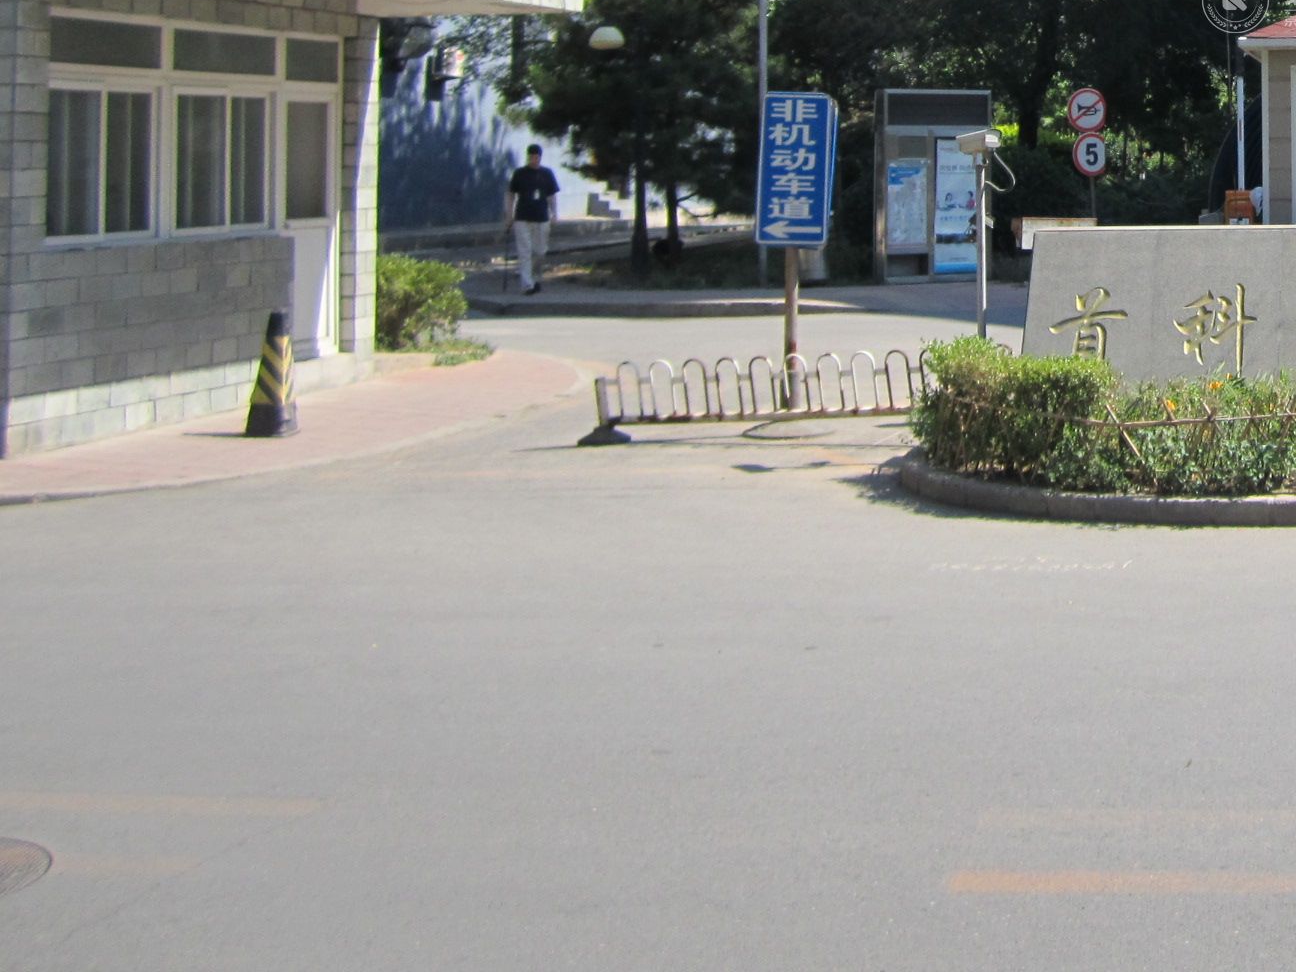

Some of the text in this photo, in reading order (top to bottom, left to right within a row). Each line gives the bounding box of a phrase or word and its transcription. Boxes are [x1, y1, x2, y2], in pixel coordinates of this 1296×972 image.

[767, 99, 819, 219] 非机动车道
[1085, 143, 1098, 166] 5
